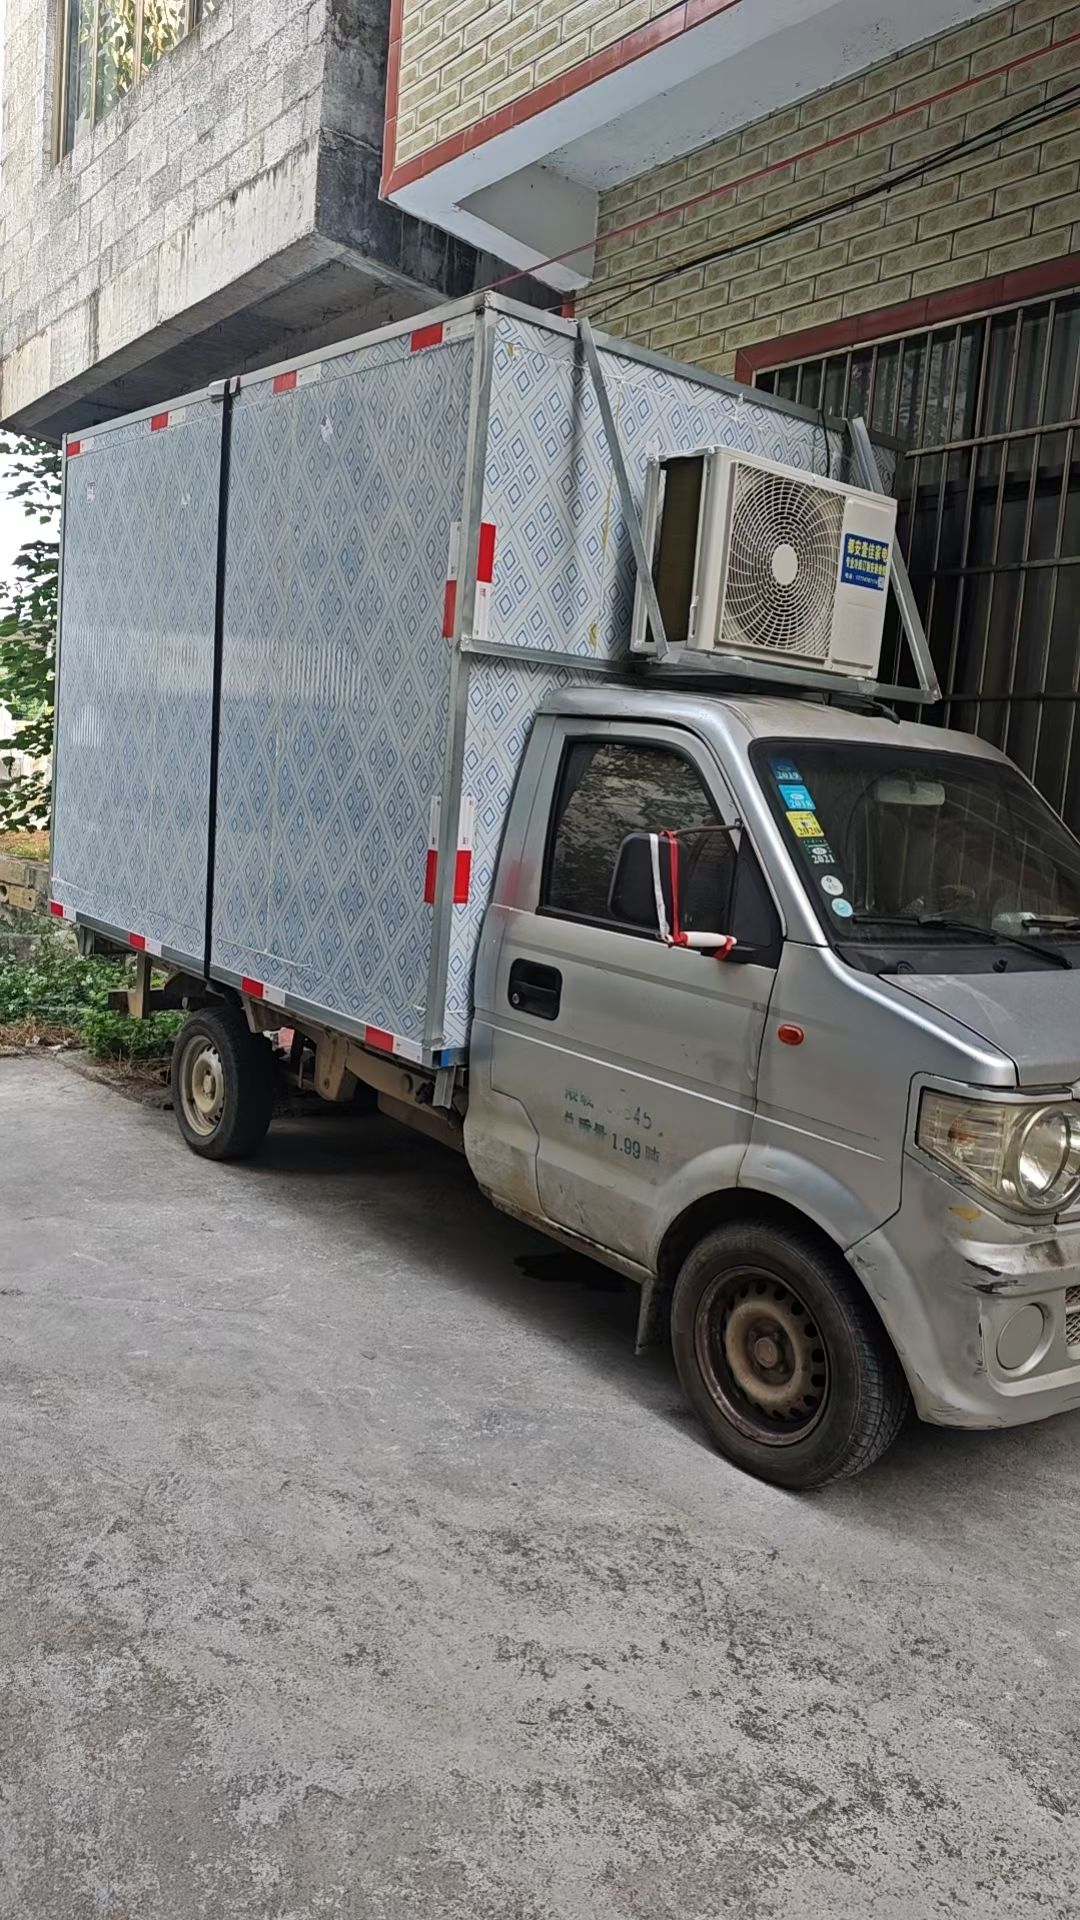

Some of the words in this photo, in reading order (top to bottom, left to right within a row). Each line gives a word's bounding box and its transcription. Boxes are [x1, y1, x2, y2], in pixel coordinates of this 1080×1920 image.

[776, 770, 800, 780] 2019
[797, 827, 822, 836] 2020
[811, 855, 836, 865] 2021
